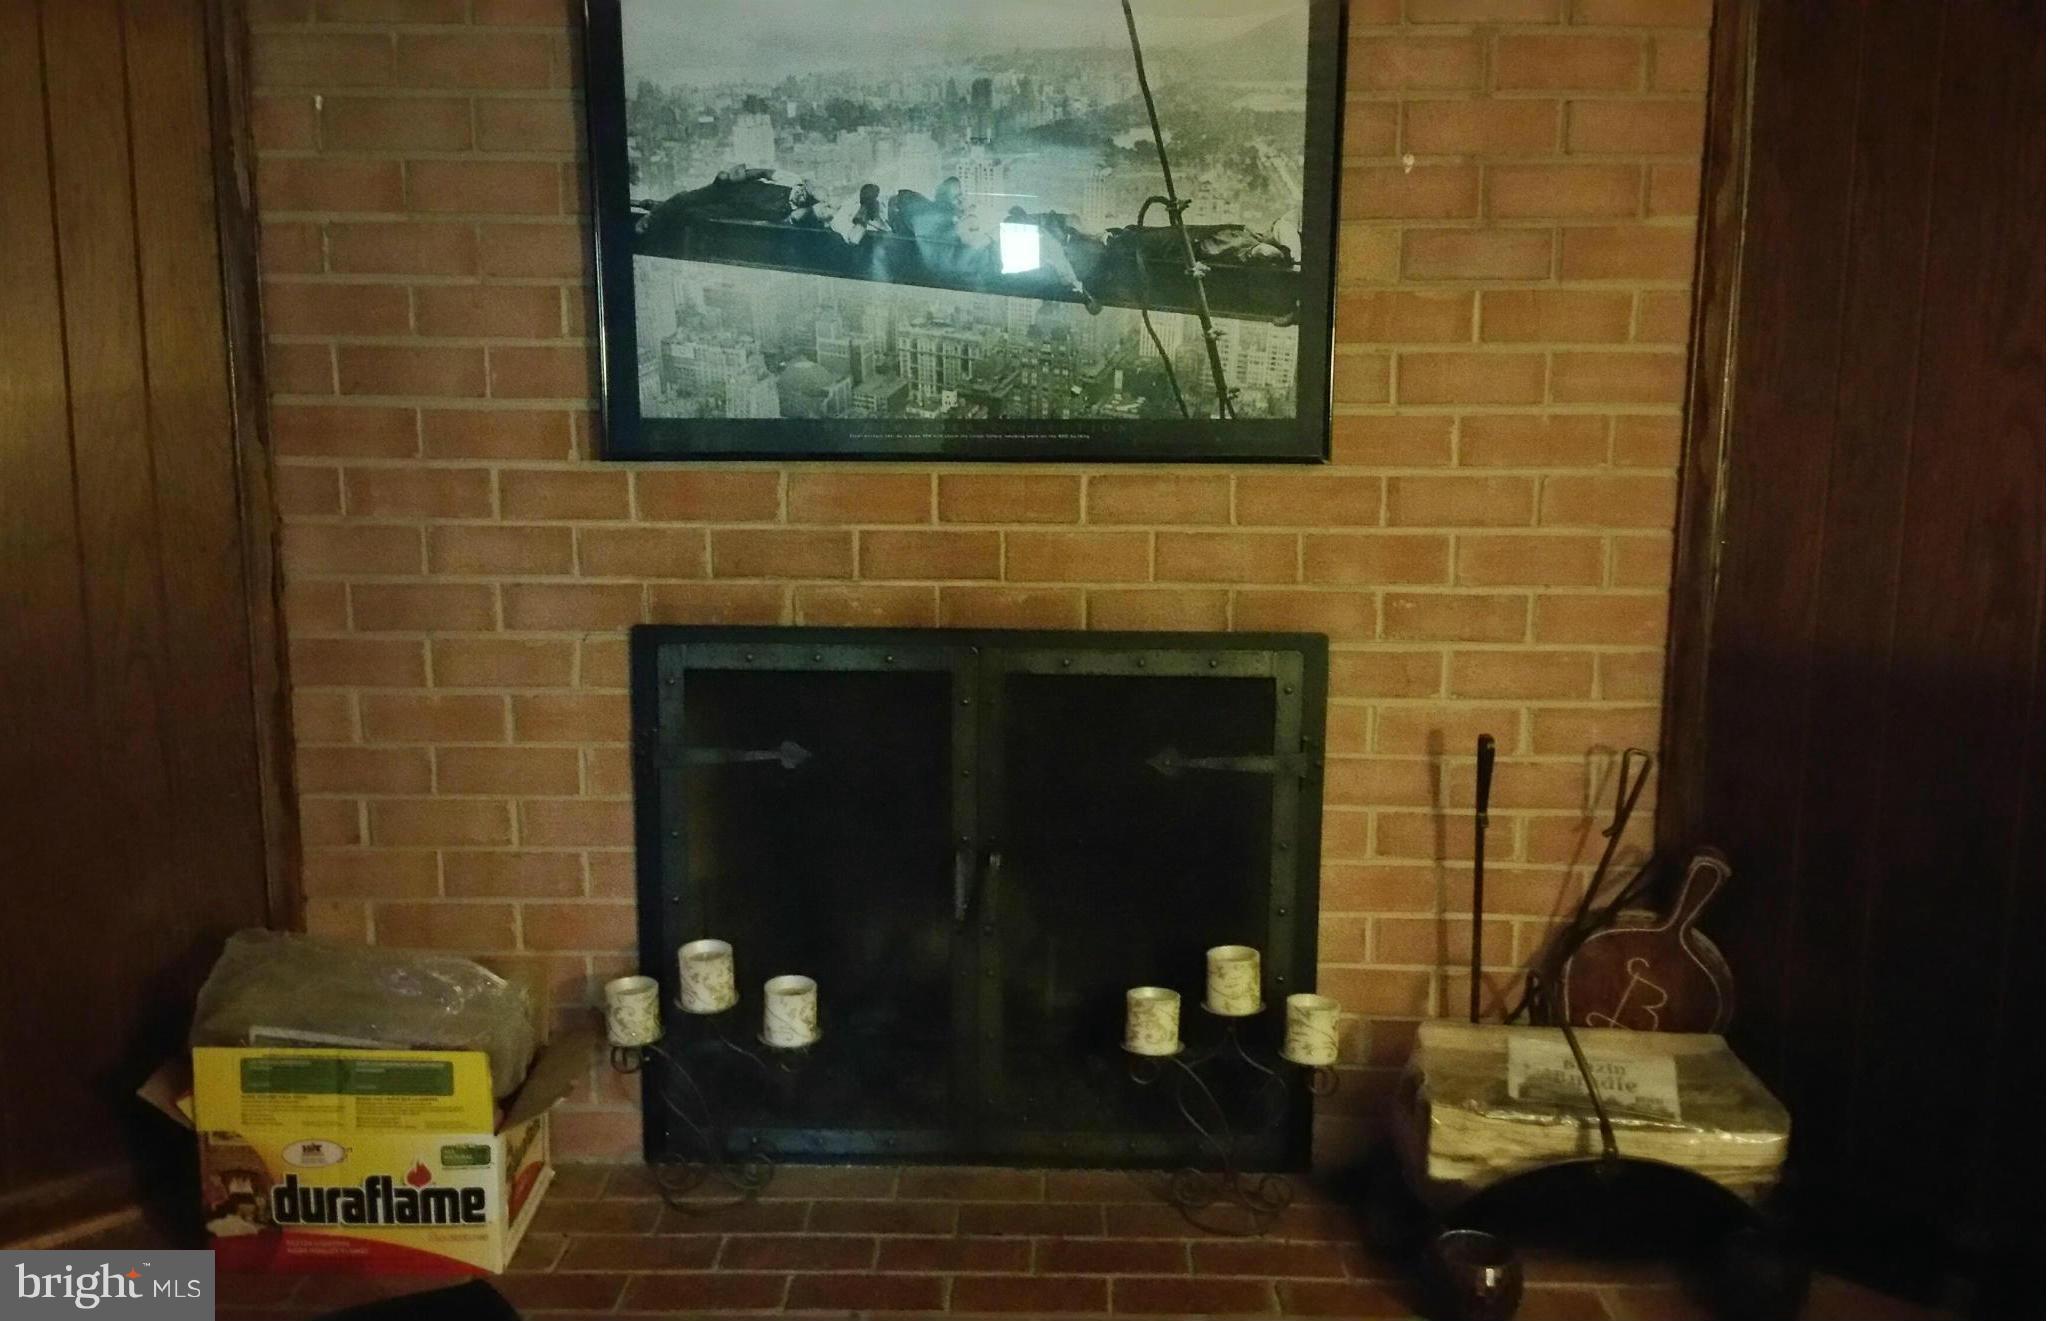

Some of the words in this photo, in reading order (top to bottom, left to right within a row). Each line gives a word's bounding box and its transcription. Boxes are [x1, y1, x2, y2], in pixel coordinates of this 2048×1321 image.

[1562, 1059, 1627, 1075] Bzin
[1555, 1069, 1638, 1093] Budle
[272, 1173, 487, 1225] duraflame
